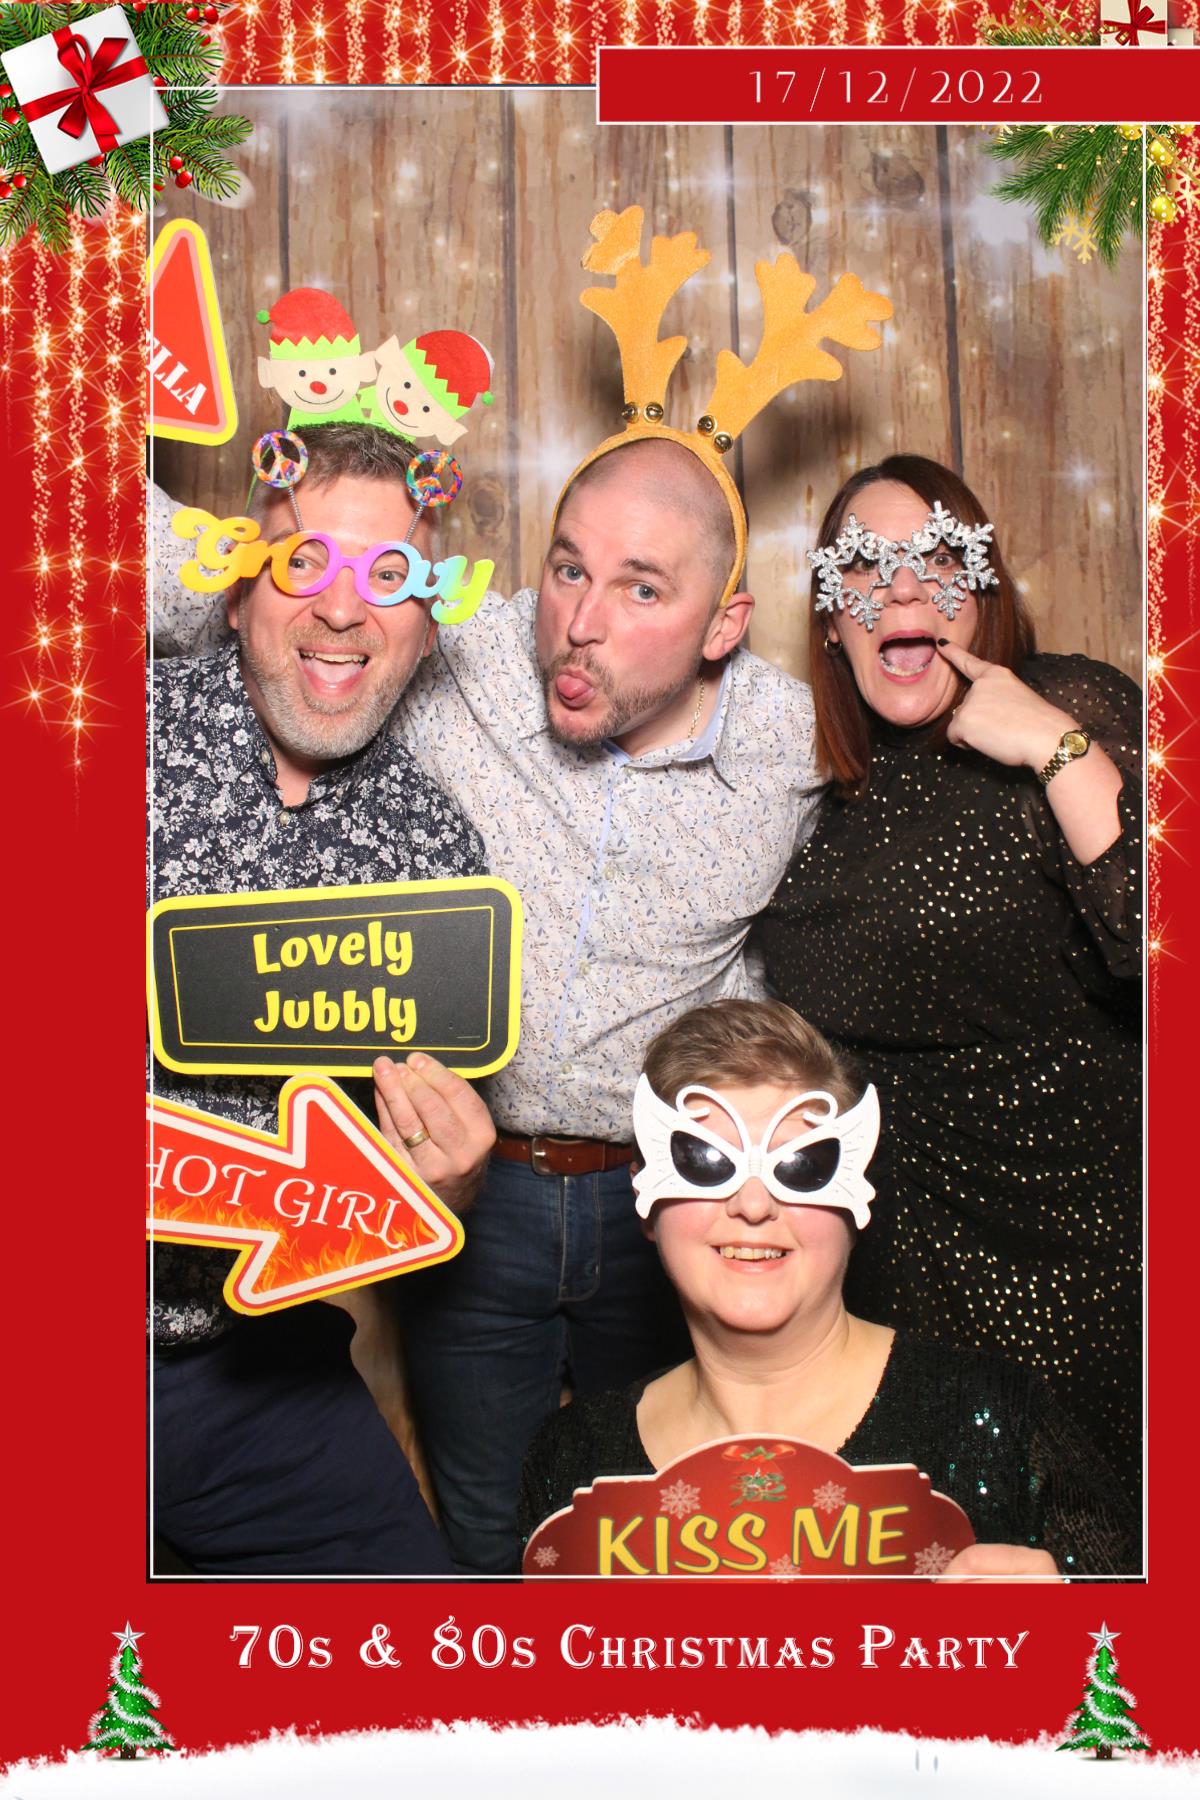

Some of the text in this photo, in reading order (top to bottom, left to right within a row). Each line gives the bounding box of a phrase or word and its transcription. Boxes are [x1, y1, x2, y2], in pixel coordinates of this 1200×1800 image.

[252, 921, 413, 976] Lovely
[253, 988, 417, 1043] Jubbly
[273, 1178, 408, 1250] GIRL
[598, 1503, 910, 1575] KISS ME
